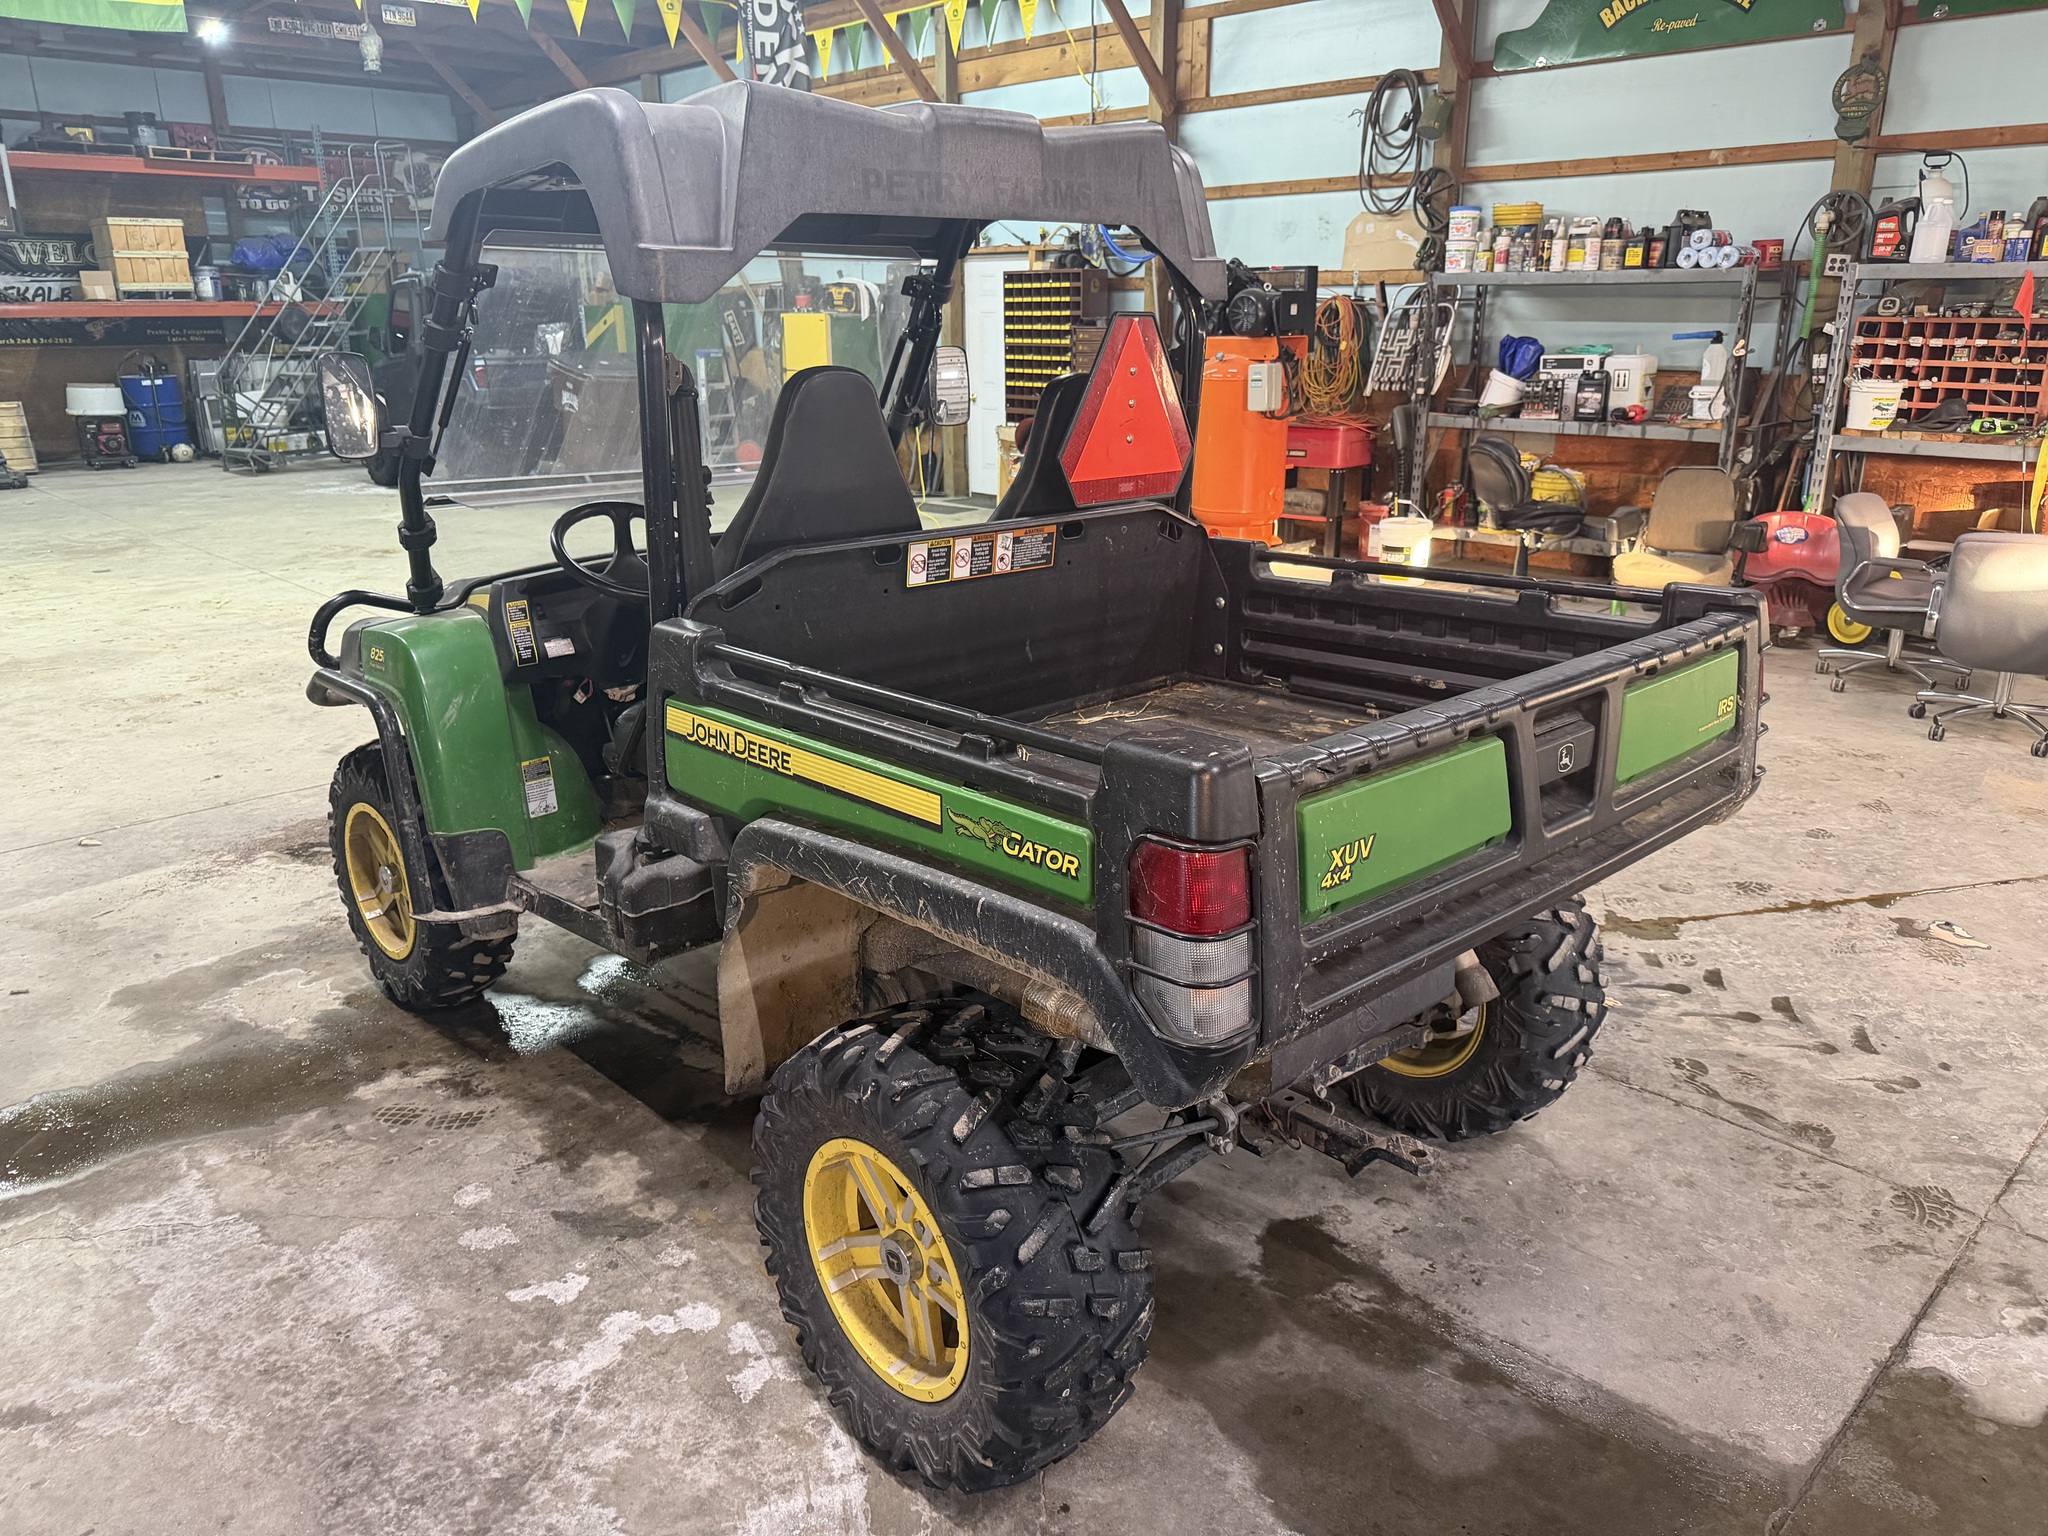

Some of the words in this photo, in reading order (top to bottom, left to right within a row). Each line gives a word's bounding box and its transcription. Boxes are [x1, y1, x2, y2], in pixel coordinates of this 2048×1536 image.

[1650, 13, 1699, 34] Re-paved
[237, 198, 263, 210] TO
[265, 198, 290, 210] GO
[1717, 695, 1735, 717] IRS
[687, 717, 731, 754] JOHN
[733, 730, 794, 774] DEERE
[1002, 832, 1080, 878] GATOR
[1329, 834, 1376, 871] XUV
[1320, 864, 1352, 890] 4x4
